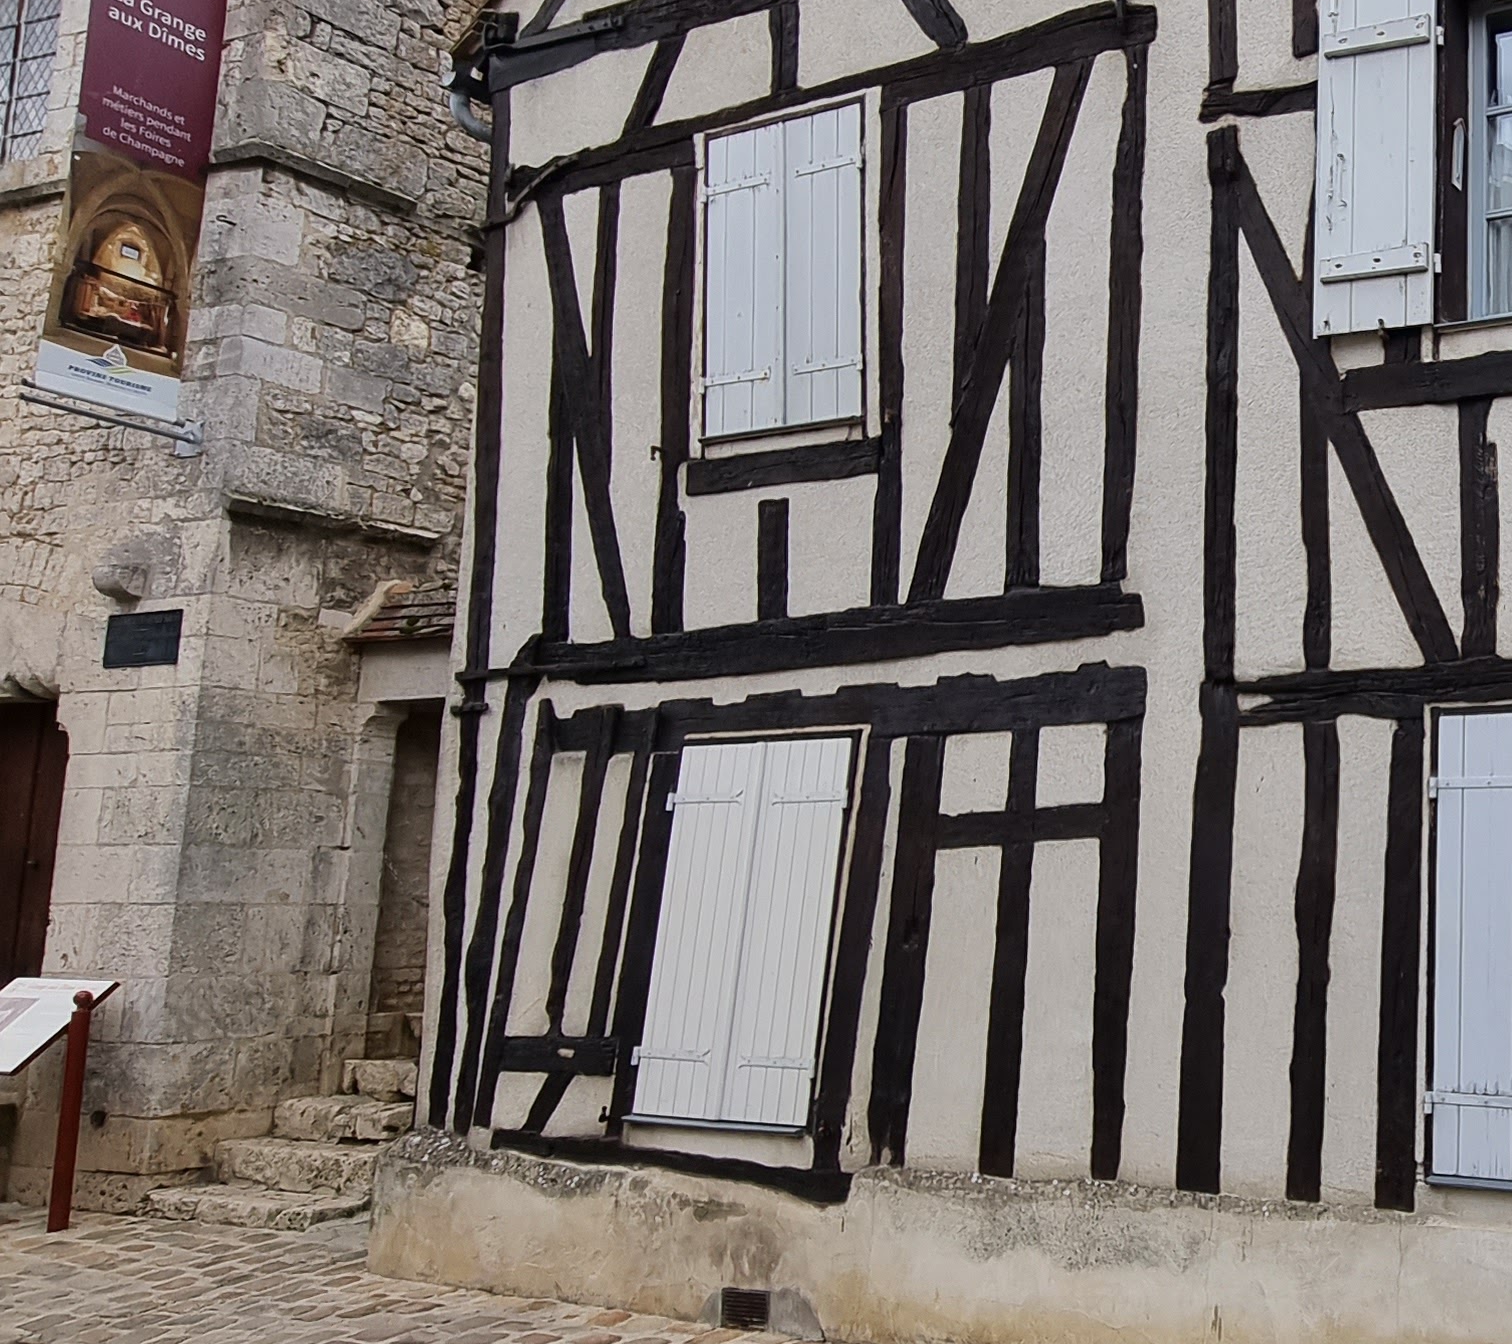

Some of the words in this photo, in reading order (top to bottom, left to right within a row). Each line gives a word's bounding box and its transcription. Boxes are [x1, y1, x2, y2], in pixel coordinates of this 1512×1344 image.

[108, 6, 143, 32] aux
[148, 22, 206, 61] Dîmes
[140, 0, 207, 42] Grange
[102, 97, 144, 122] métiers
[146, 117, 191, 142] pendant
[112, 85, 172, 120] Marchands
[174, 115, 185, 125] et
[102, 127, 117, 139] de
[119, 132, 185, 167] Champagne
[120, 117, 137, 133] les
[139, 126, 172, 147] Foires
